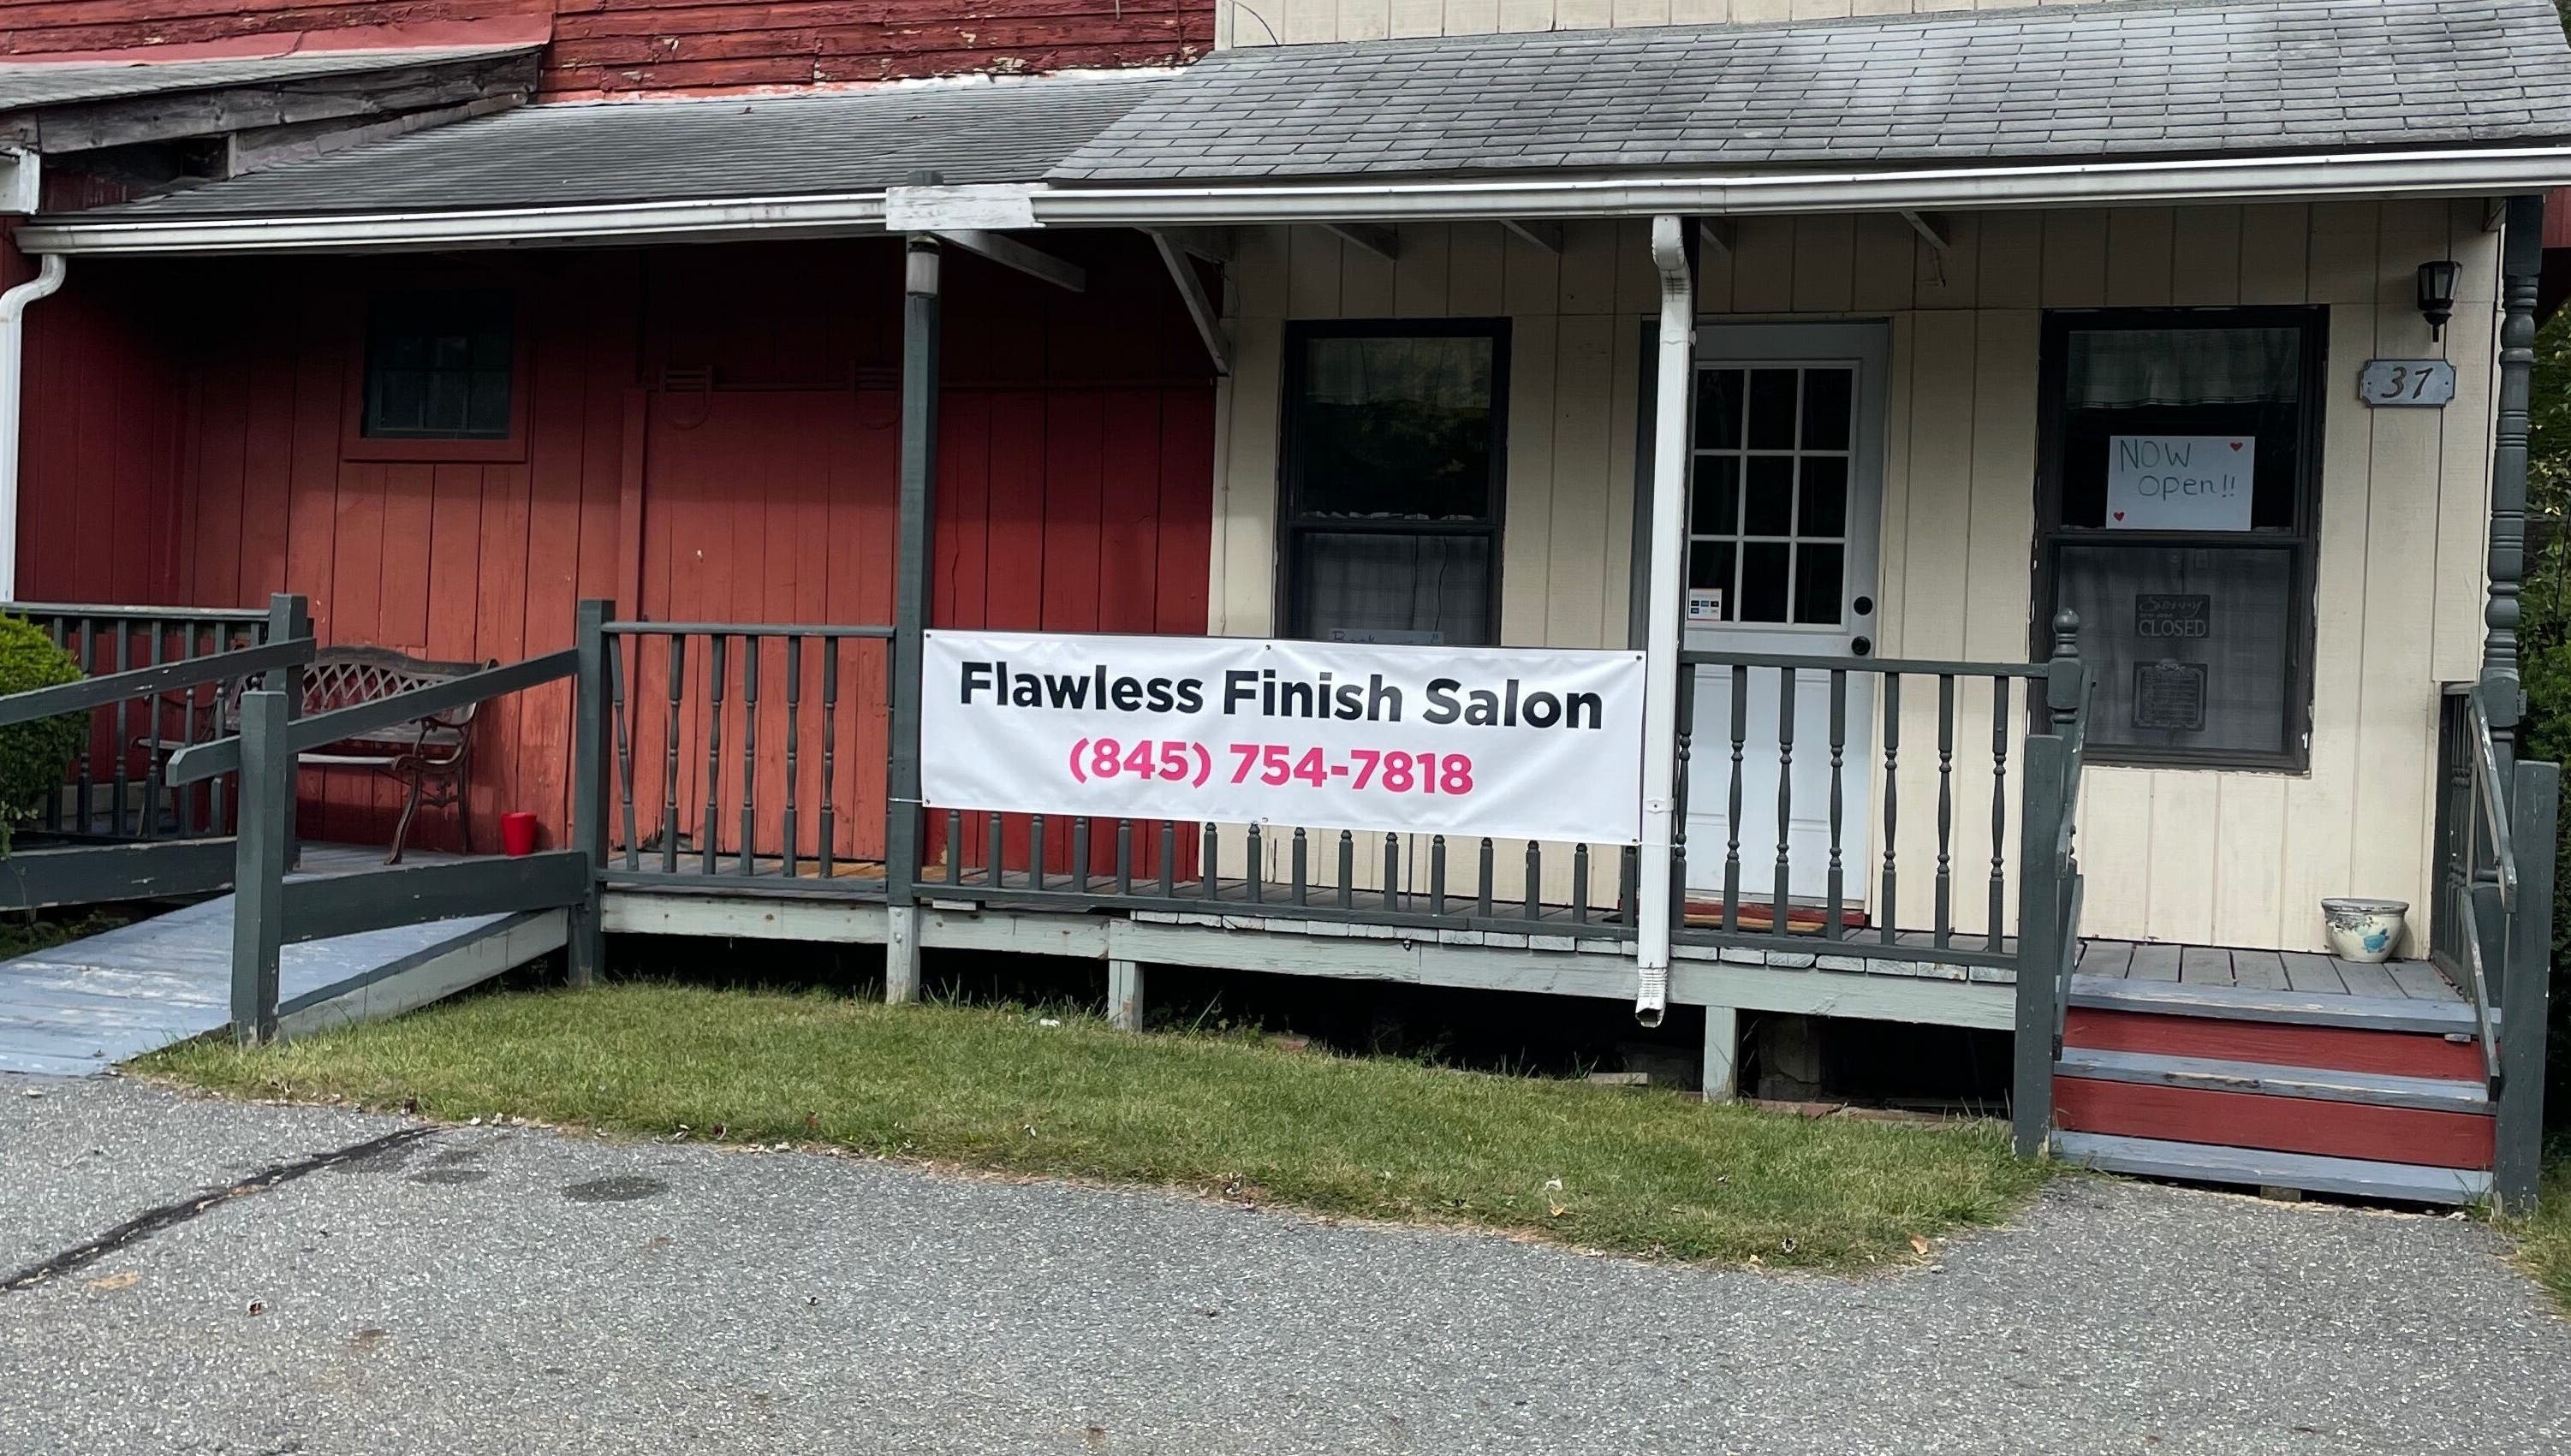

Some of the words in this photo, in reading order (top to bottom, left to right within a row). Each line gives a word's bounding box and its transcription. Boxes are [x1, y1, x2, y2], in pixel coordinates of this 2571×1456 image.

[2381, 366, 2433, 399] 37
[2120, 439, 2191, 472] NOW
[2139, 620, 2206, 637] CLOSED
[961, 662, 1203, 713] Flawless
[1224, 669, 1402, 722] Finish
[1423, 679, 1602, 729] Salon
[1069, 738, 1211, 787] (845)
[1230, 744, 1473, 795] 754-7818
